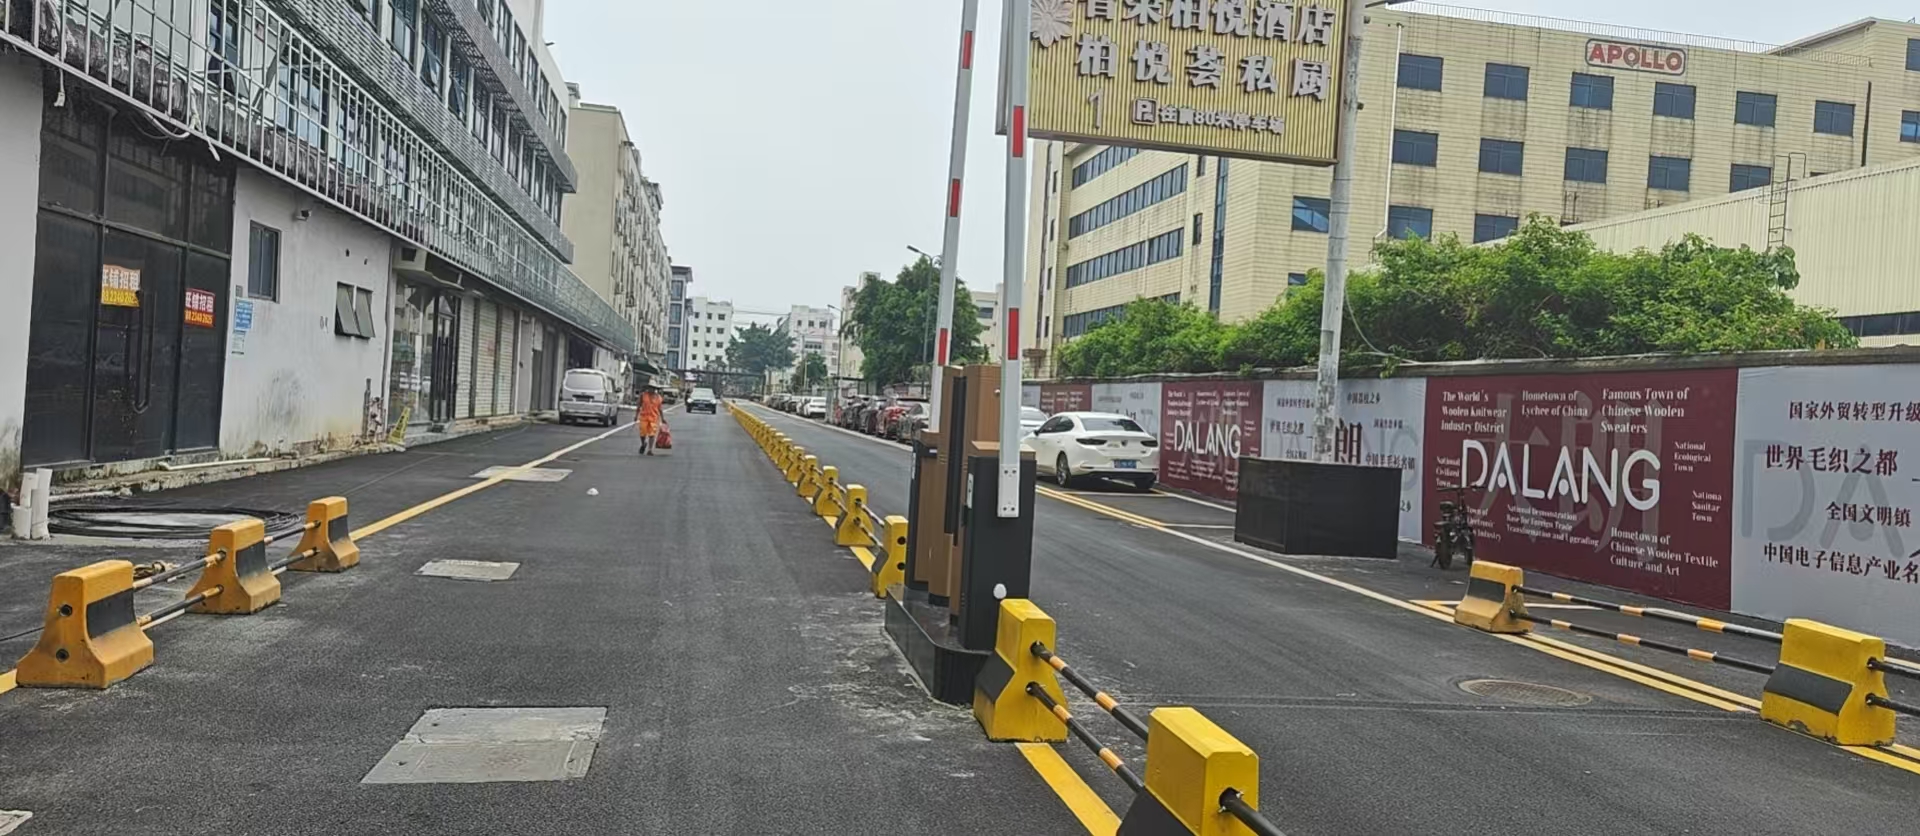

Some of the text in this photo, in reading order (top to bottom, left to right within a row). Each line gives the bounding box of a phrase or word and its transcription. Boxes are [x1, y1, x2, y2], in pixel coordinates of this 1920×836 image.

[1589, 43, 1682, 71] APOLLO
[1076, 32, 1331, 100] 柏悦荟私厨
[1443, 391, 1456, 401] The
[1522, 390, 1578, 402] Hometown of
[1602, 387, 1690, 400] Famous Town of
[1442, 405, 1508, 418] Woolen Knitwear
[1521, 404, 1588, 418] Lychee of China
[1601, 404, 1685, 418] Chinese Woolen
[1789, 401, 1920, 422] 国家外贸转型升级
[1441, 420, 1504, 435] Industry District
[1600, 421, 1648, 434] Sweaters
[1174, 419, 1242, 460] DALANG
[1674, 441, 1706, 451] National
[1674, 452, 1711, 463] Ecological
[1766, 444, 1898, 477] 世界毛织之都
[1461, 439, 1661, 512] DALANG
[1673, 463, 1695, 473] Town
[1692, 511, 1713, 522] Town
[1826, 501, 1912, 528] 全国文明镇
[1610, 527, 1671, 545] Hometown of
[1610, 541, 1720, 568] Chinese Woolen Textile
[1610, 554, 1681, 576] Culture and Art
[1763, 542, 1920, 584] 中国电子信息产业名
